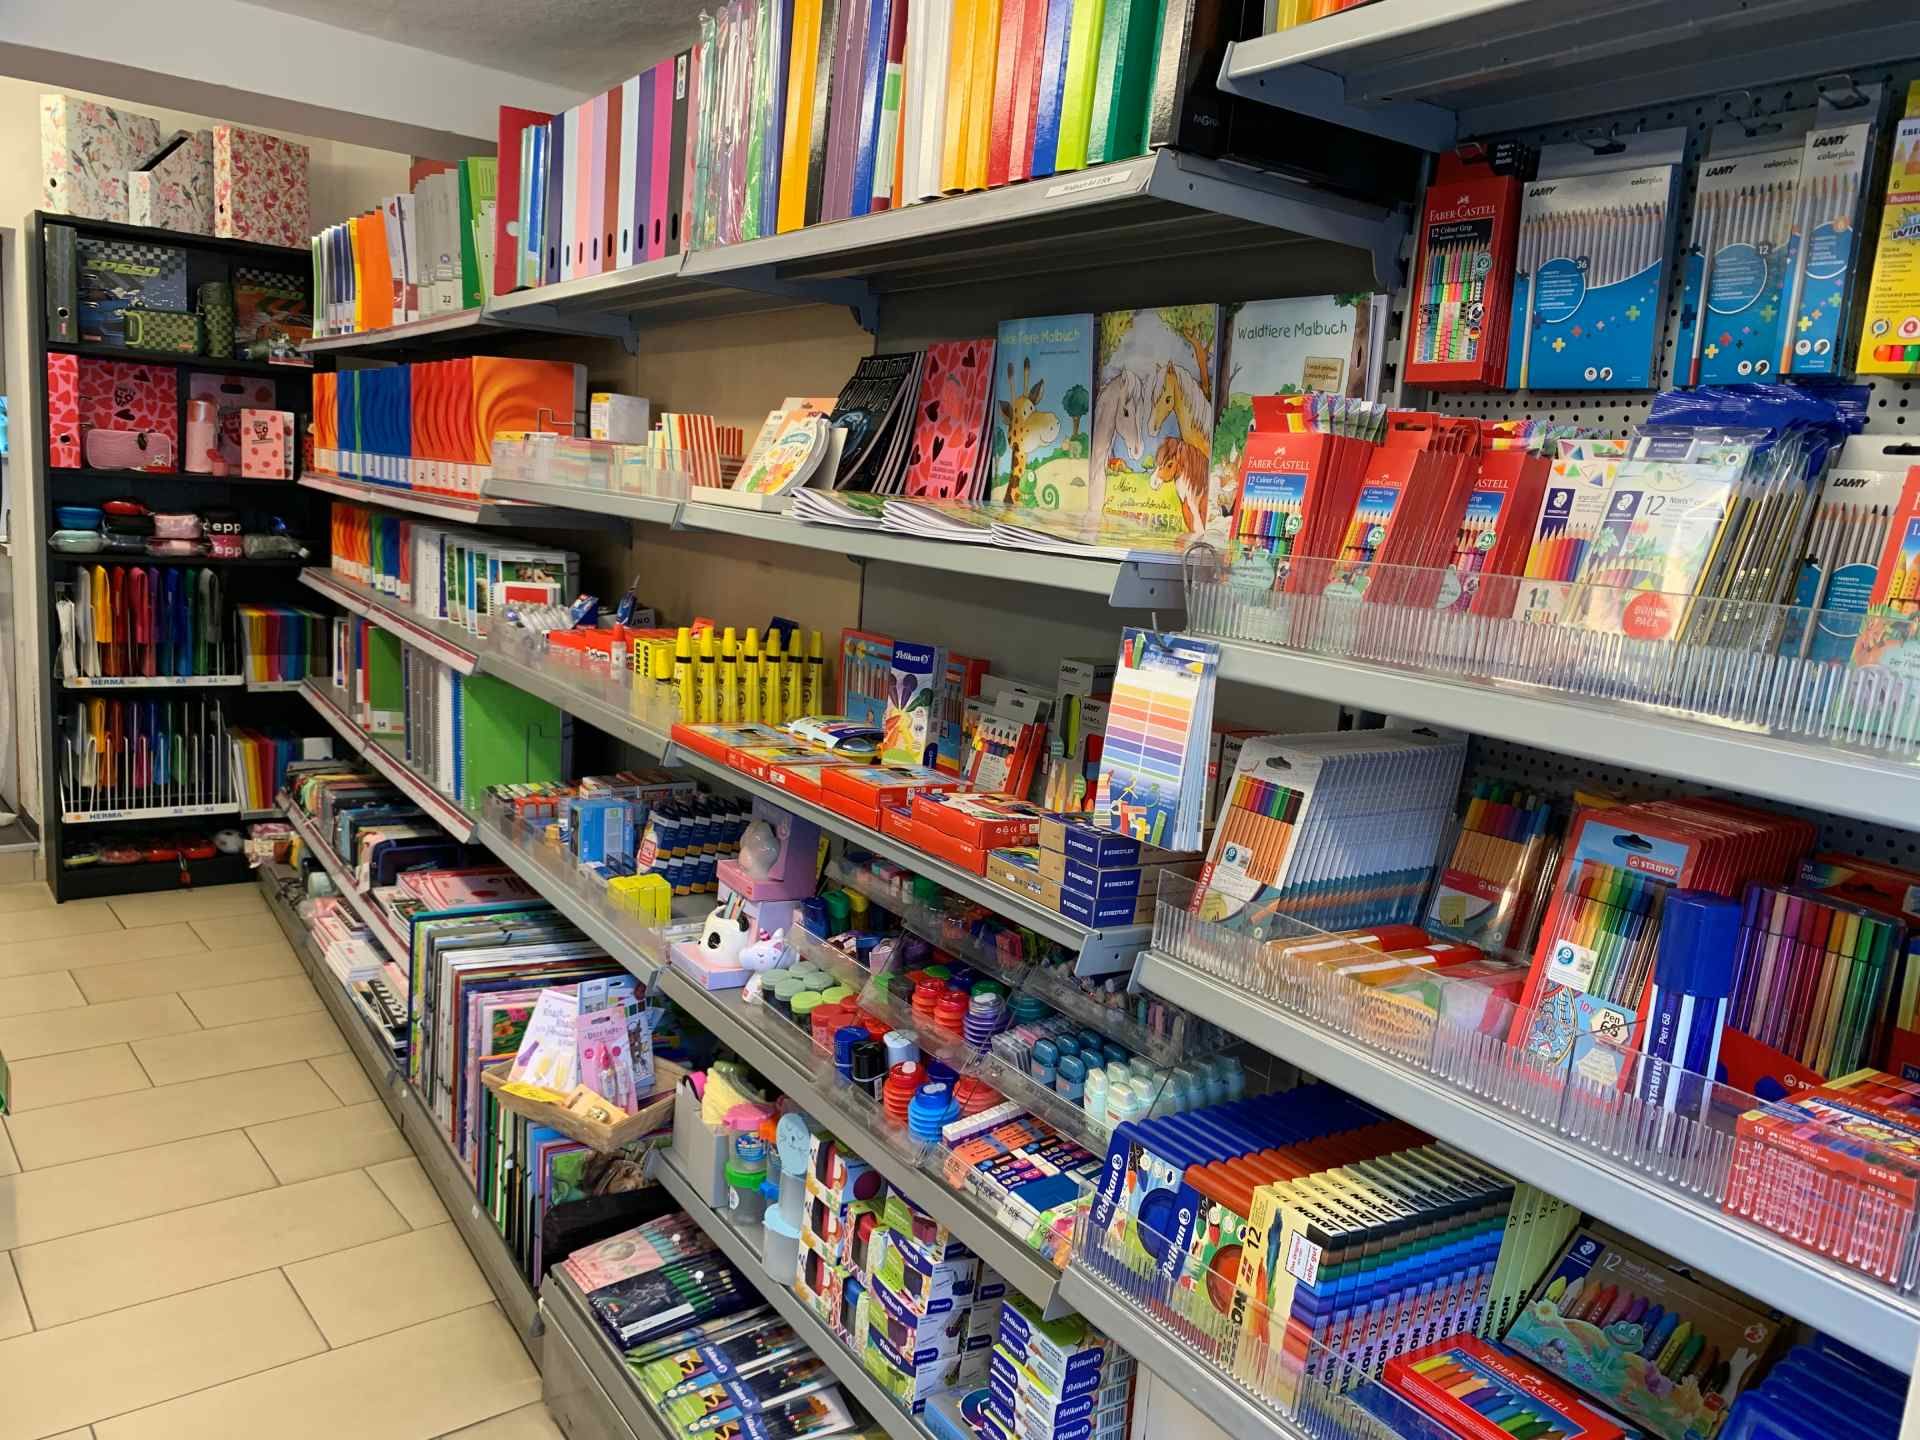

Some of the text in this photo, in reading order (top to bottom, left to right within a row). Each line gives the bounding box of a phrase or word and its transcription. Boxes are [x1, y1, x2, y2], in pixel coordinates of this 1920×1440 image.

[1812, 134, 1849, 148] LAMY
[1817, 150, 1856, 161] colorplus
[1706, 164, 1738, 177] LAMY
[1529, 186, 1557, 197] LAMY
[1430, 204, 1497, 222] FABER-CASTELL
[1758, 245, 1770, 256] 12
[87, 259, 161, 276] SPEED
[1576, 259, 1588, 269] 36
[1238, 319, 1348, 340] Waldtiere Malbuch
[1247, 455, 1312, 472] FABER-CASTELL
[1248, 475, 1256, 486] 12
[1274, 477, 1286, 487] Grip
[1475, 479, 1510, 489] ASTELL
[1833, 477, 1871, 489] LAMY
[1645, 495, 1667, 517] 12
[895, 650, 921, 662] Pelikan
[89, 812, 122, 820] HERMA
[1639, 860, 1677, 876] STABILO
[1603, 1011, 1620, 1024] Pen
[1600, 1021, 1620, 1038] 68
[1646, 1013, 1671, 1106] STABILO Pen 68
[1754, 1126, 1764, 1135] 10
[1097, 1172, 1119, 1224] Pelikan
[1333, 1197, 1377, 1223] JAXON
[1350, 1193, 1394, 1218] JAXON
[1294, 1206, 1340, 1232] JAXON
[1313, 1202, 1358, 1228] JAXON
[1509, 1216, 1517, 1229] 12
[1247, 1226, 1262, 1250] 12
[1163, 1224, 1187, 1278] Pelikan
[1602, 1252, 1622, 1272] 12
[1464, 1288, 1473, 1302] 12
[1480, 1284, 1488, 1296] 12
[1433, 1299, 1442, 1312] 12
[1448, 1294, 1457, 1307] 12
[1401, 1310, 1410, 1324] 12
[1417, 1305, 1426, 1318] 12
[1003, 1311, 1022, 1332] Pelikan
[1385, 1316, 1394, 1330] 12
[1352, 1328, 1361, 1342] 12
[1369, 1322, 1378, 1336] 12
[1333, 1334, 1341, 1348] 12
[1069, 1358, 1093, 1370] Pelikan
[1066, 1380, 1090, 1393] Pelikan
[1480, 1354, 1570, 1413] FABER-CASTELL
[1059, 1404, 1083, 1418] Pelikan
